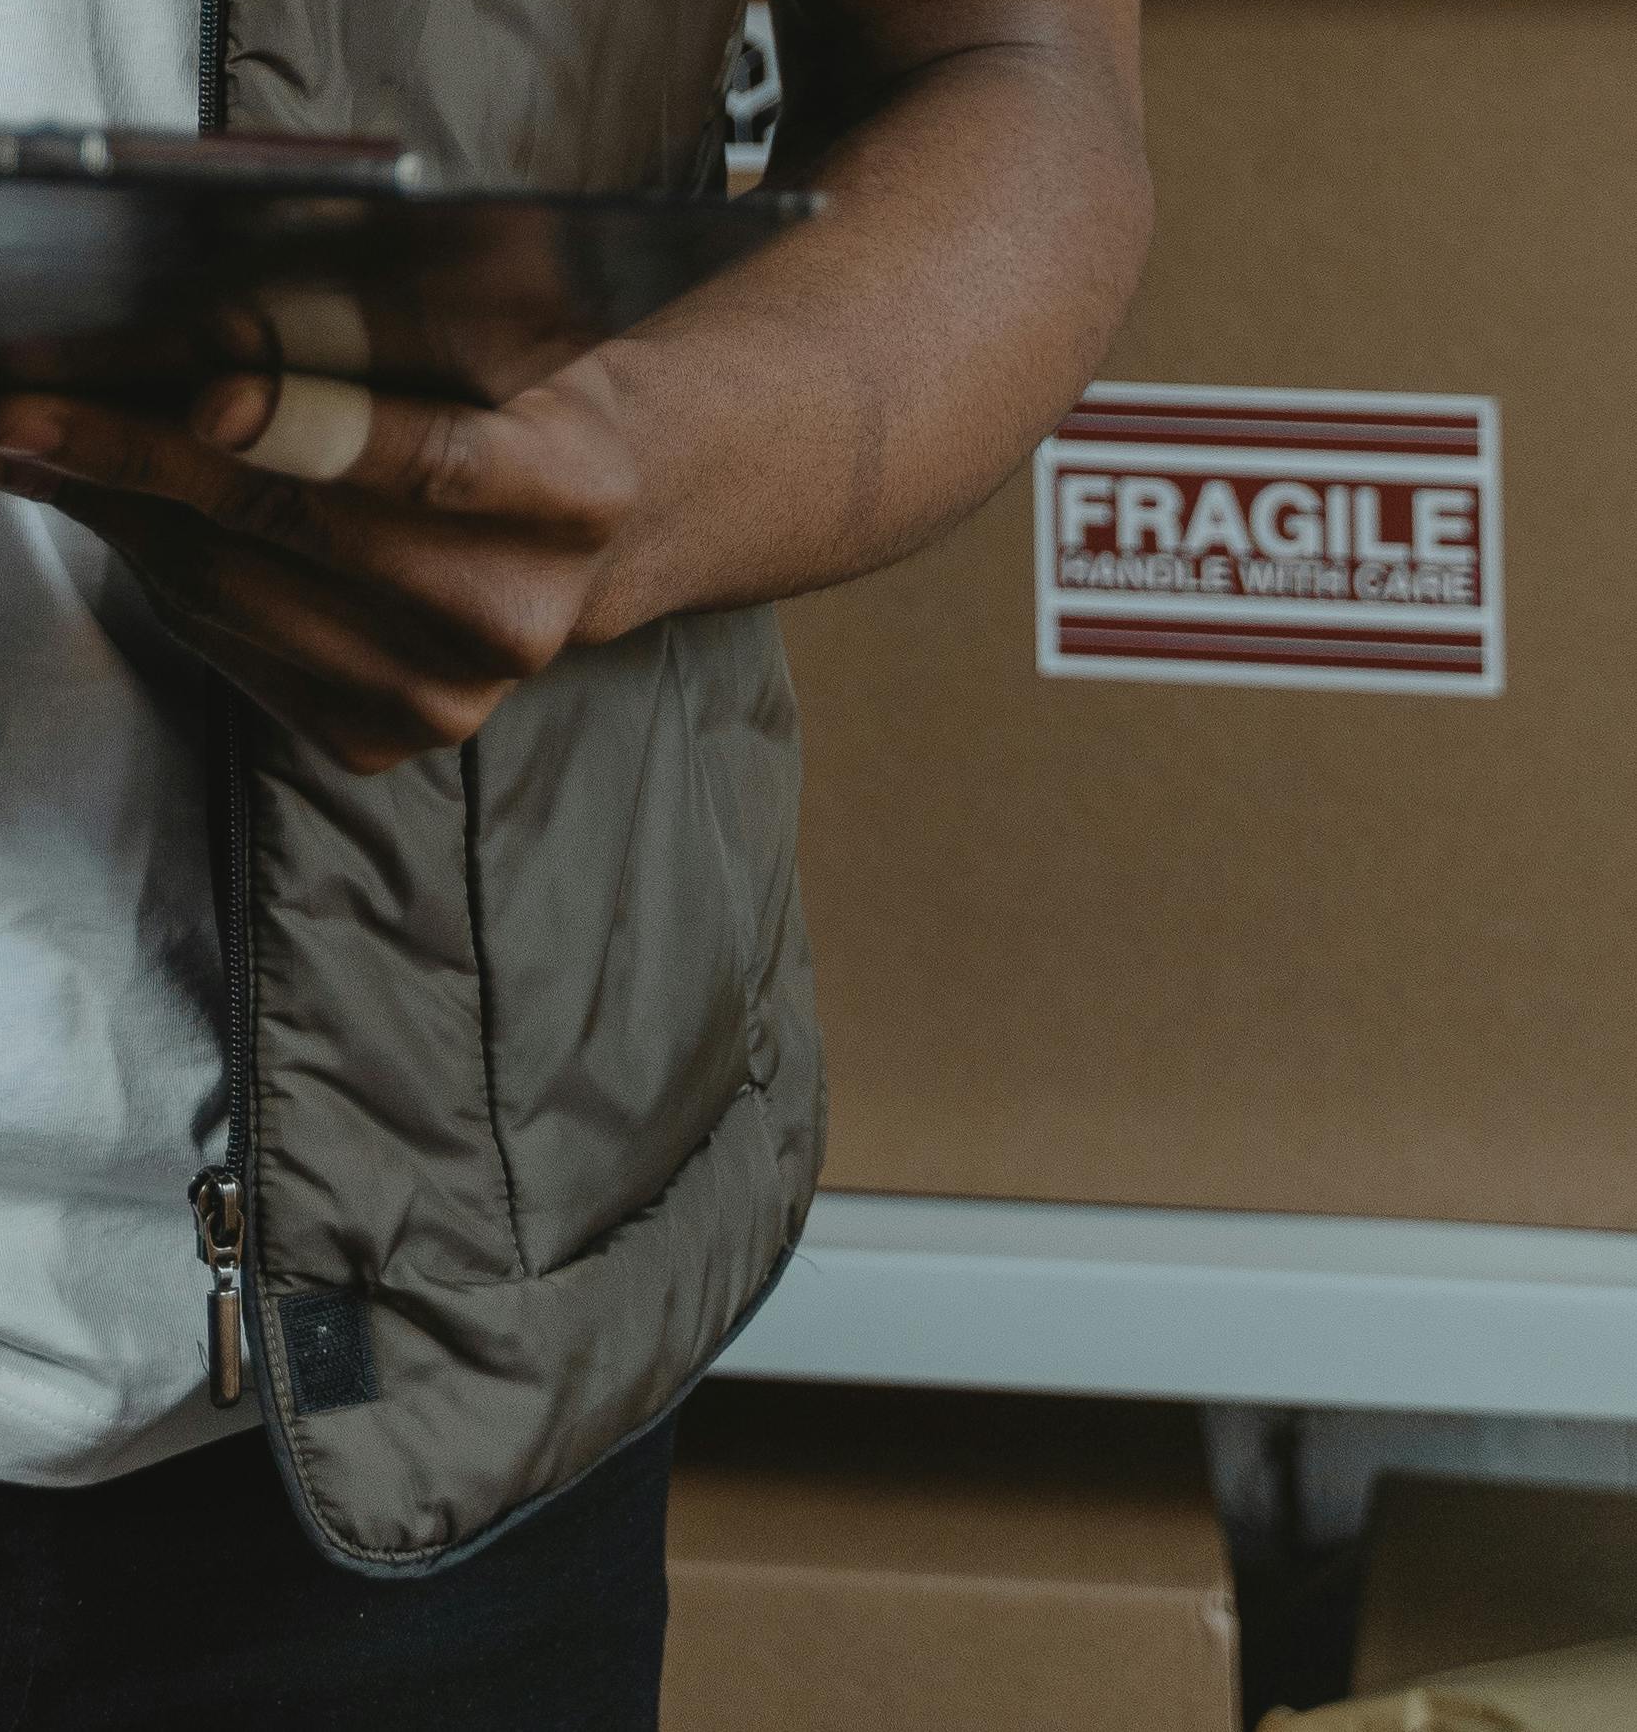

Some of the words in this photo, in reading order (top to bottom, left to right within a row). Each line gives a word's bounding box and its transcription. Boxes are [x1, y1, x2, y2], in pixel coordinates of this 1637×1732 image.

[1060, 474, 1477, 564] FRAGILE
[1239, 558, 1351, 599] WITH
[1355, 563, 1477, 604] CARE
